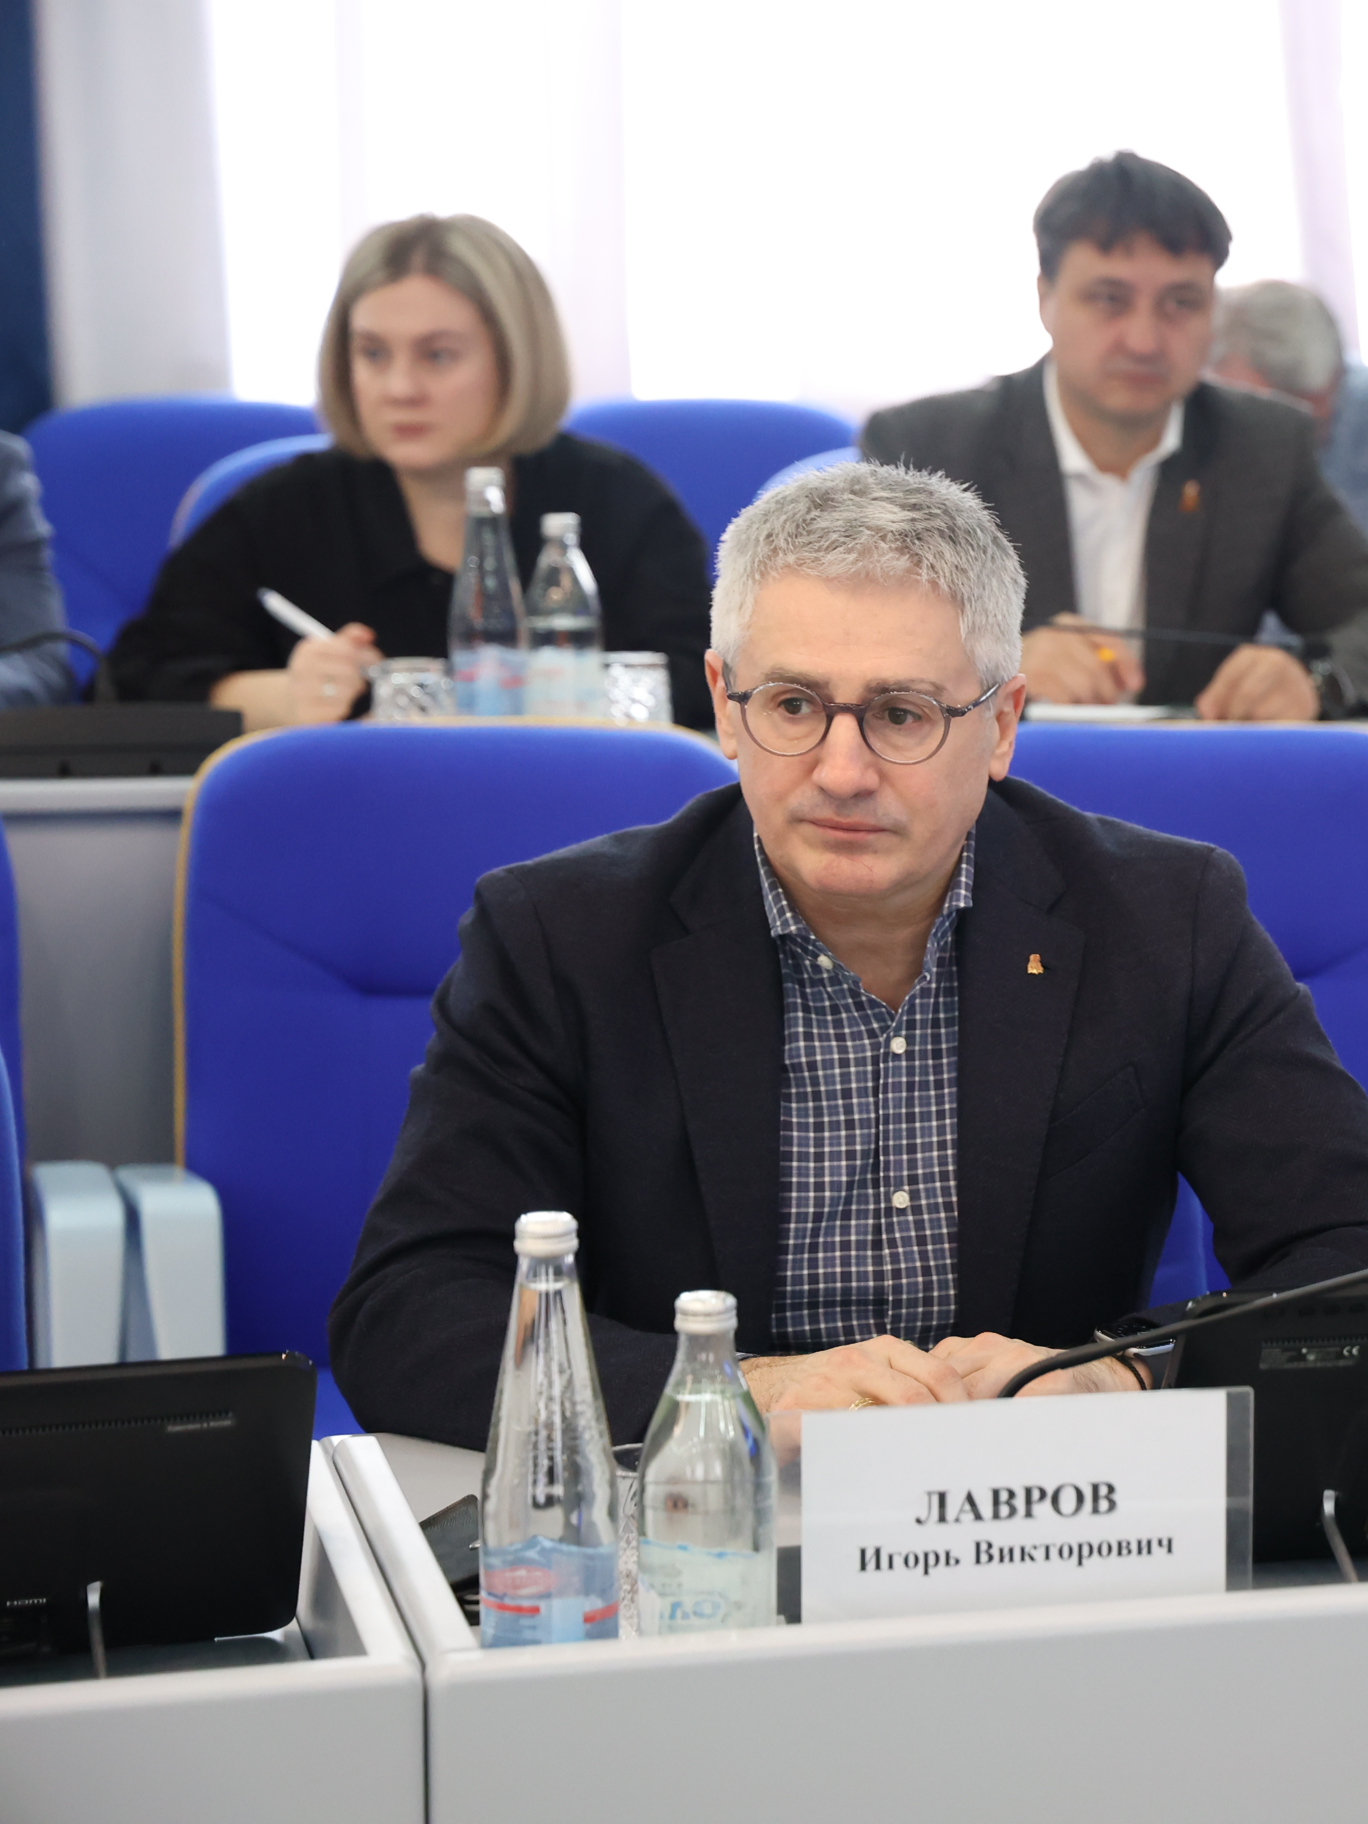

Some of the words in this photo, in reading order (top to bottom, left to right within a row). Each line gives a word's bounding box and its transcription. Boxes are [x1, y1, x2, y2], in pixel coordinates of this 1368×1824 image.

[915, 1481, 1118, 1526] ЛАВРОВ
[858, 1545, 960, 1576] Игорь
[974, 1535, 1175, 1567] Викторович
